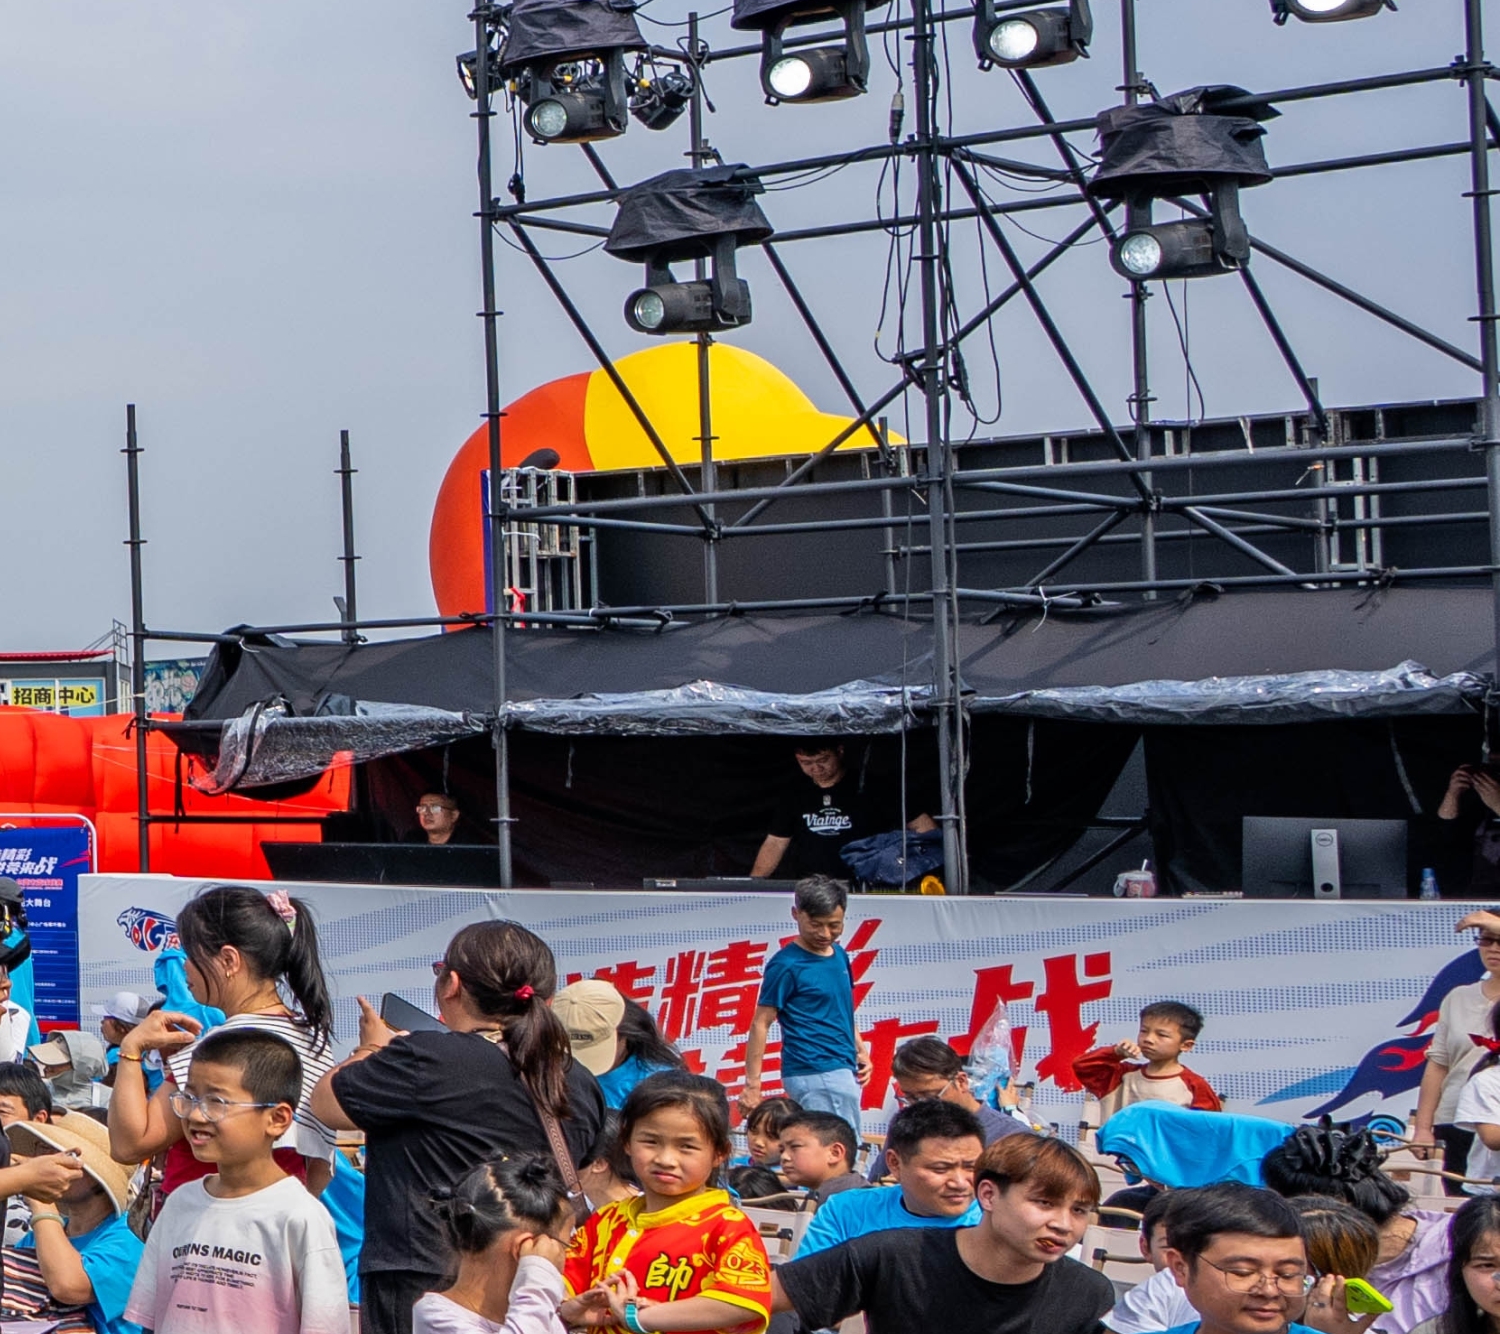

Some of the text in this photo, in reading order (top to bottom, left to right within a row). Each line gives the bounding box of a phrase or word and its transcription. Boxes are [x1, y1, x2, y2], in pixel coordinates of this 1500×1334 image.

[13, 686, 95, 706] 招商中心
[212, 1246, 262, 1266] MAGIC
